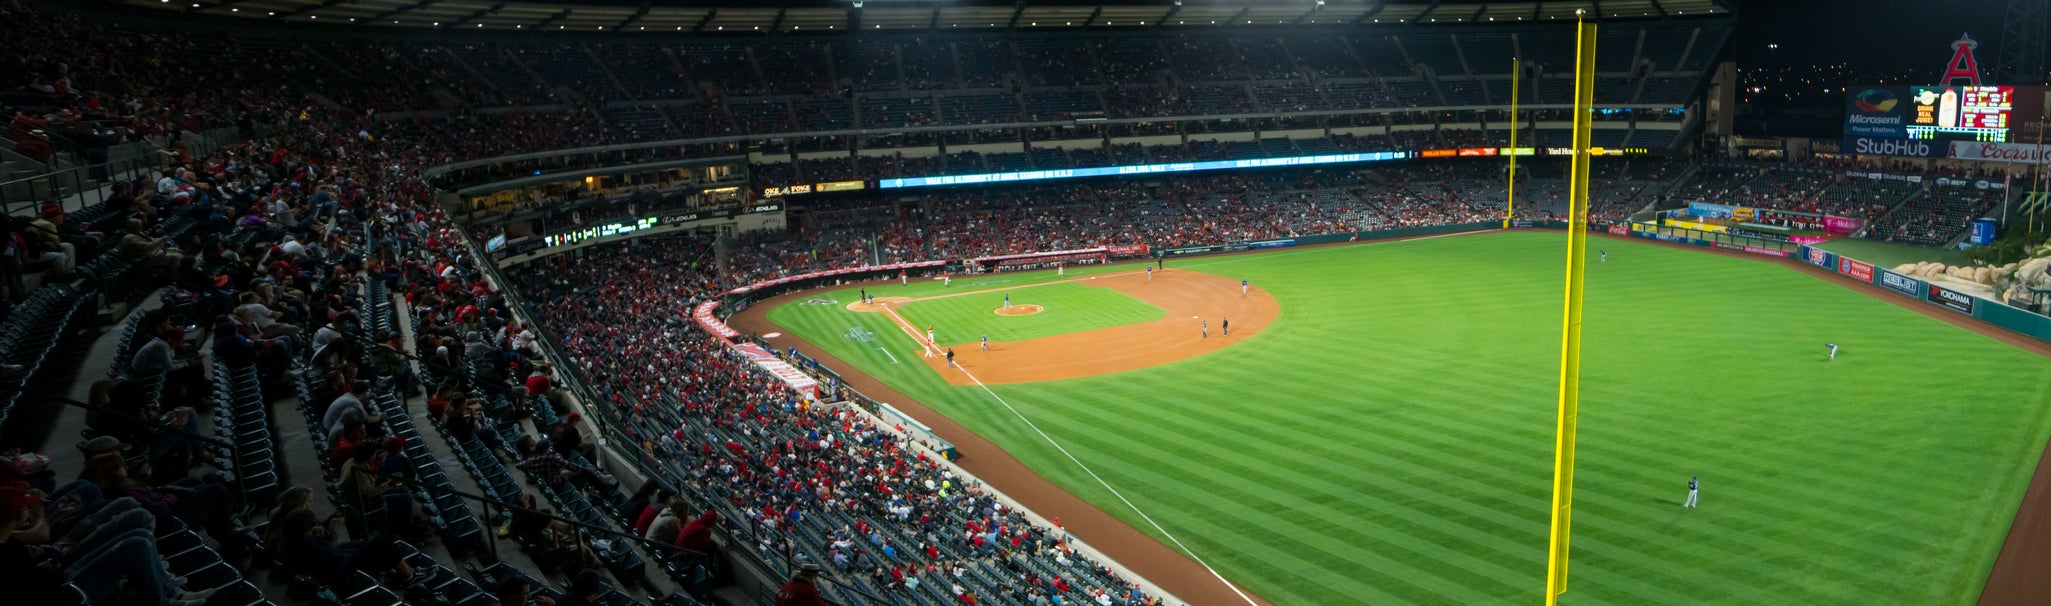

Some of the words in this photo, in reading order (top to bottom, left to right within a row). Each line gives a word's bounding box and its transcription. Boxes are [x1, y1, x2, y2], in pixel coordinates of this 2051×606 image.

[1939, 32, 1982, 86] A
[1849, 114, 1901, 125] Microsemi
[1813, 141, 1840, 152] Modelo
[1856, 138, 1930, 156] StubHub
[1981, 142, 2030, 160] Coors
[1236, 159, 1250, 167] WALK
[925, 177, 942, 185] WALK
[943, 176, 954, 184] FOR
[1019, 171, 1044, 180] STADIUM
[671, 214, 697, 222] LEXUS
[1851, 269, 1870, 279] AAA.com
[1940, 289, 1970, 305] YOKOHAMA
